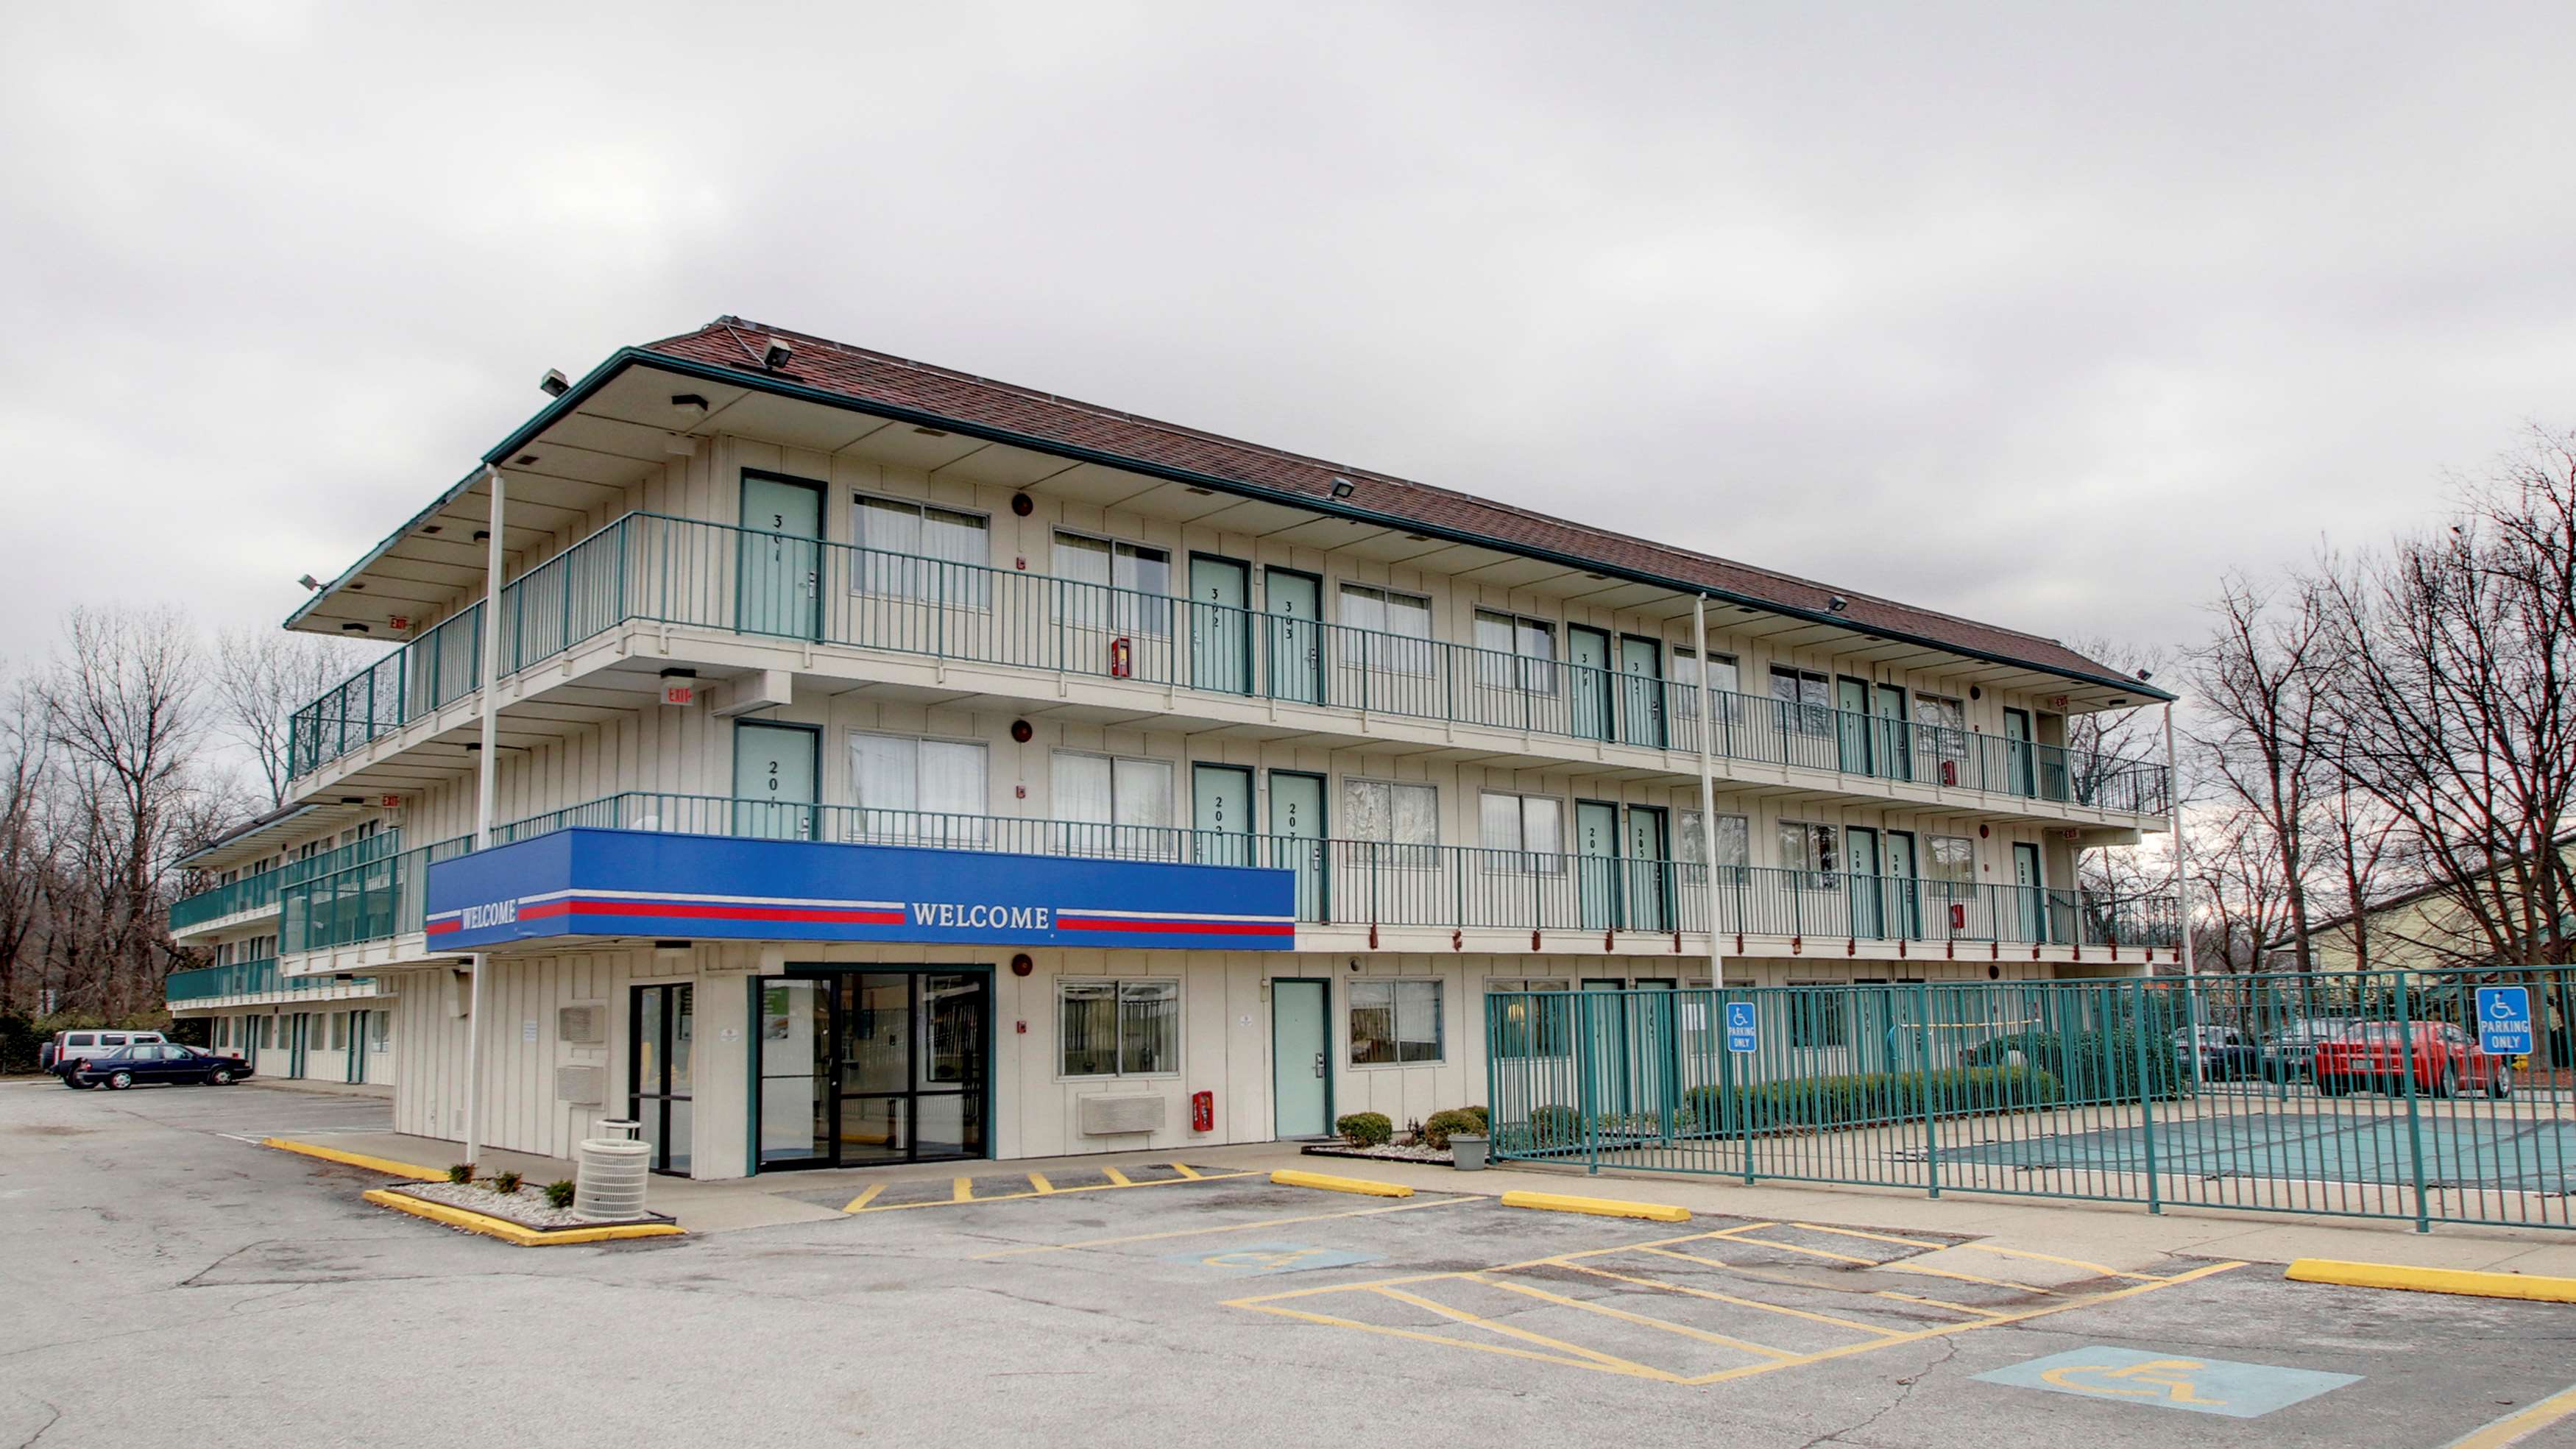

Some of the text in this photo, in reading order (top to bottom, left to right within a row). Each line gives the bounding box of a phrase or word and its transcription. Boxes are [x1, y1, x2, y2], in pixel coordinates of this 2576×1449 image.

[668, 687, 690, 703] EXIT
[462, 899, 516, 930] WELCOME
[912, 902, 1050, 929] WELCOME
[1728, 1027, 1755, 1036] PARKING
[2481, 1020, 2529, 1032] PARKING
[1733, 1038, 1749, 1047] ONLY
[2491, 1035, 2520, 1048] ONLY
